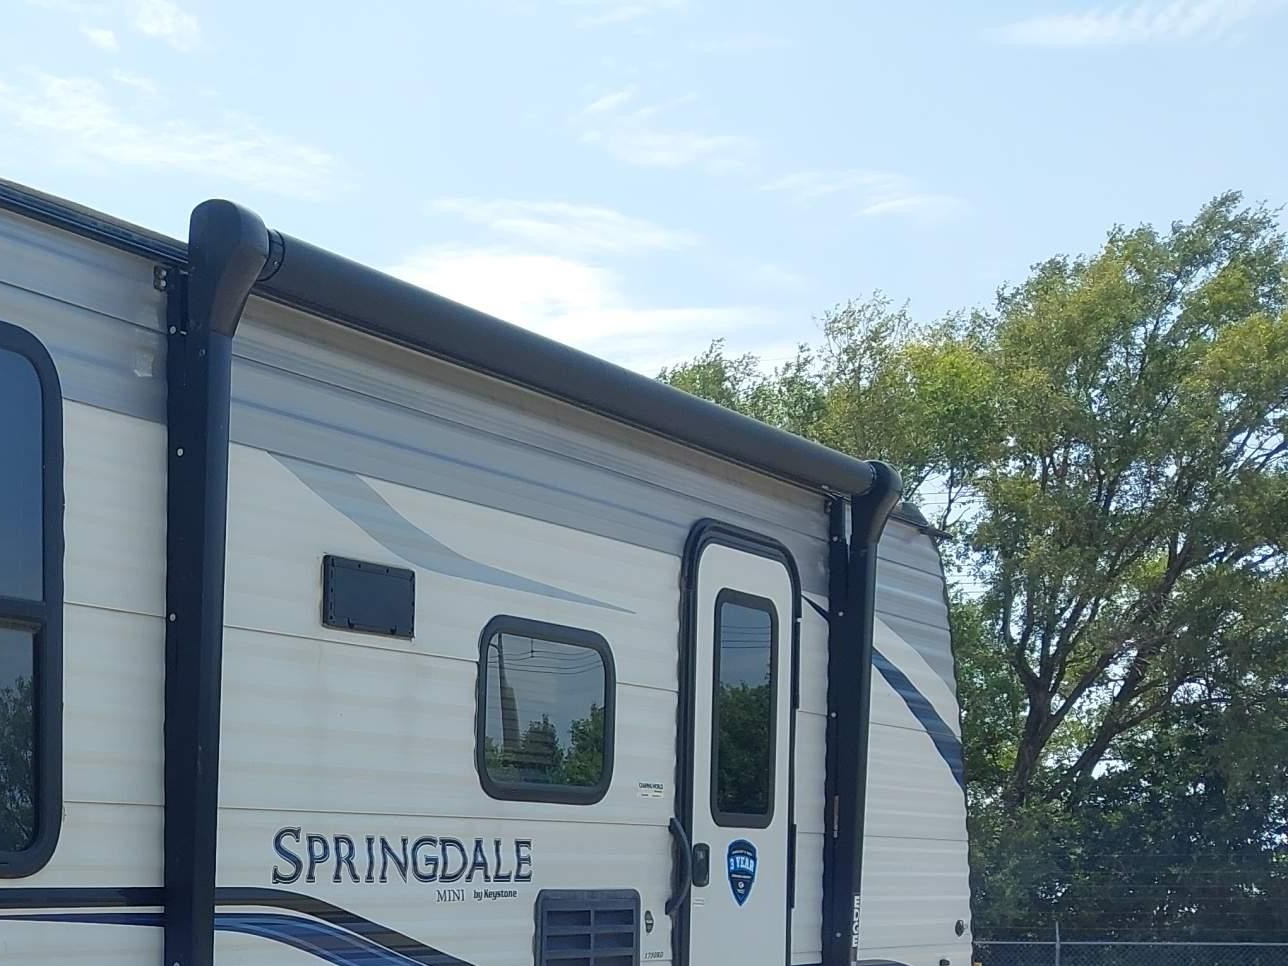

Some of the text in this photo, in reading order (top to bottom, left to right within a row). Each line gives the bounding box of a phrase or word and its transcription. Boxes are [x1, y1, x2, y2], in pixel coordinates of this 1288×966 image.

[271, 826, 533, 885] SPRINGDALE
[735, 855, 755, 873] YEAR
[436, 888, 518, 903] MINI by Keystone
